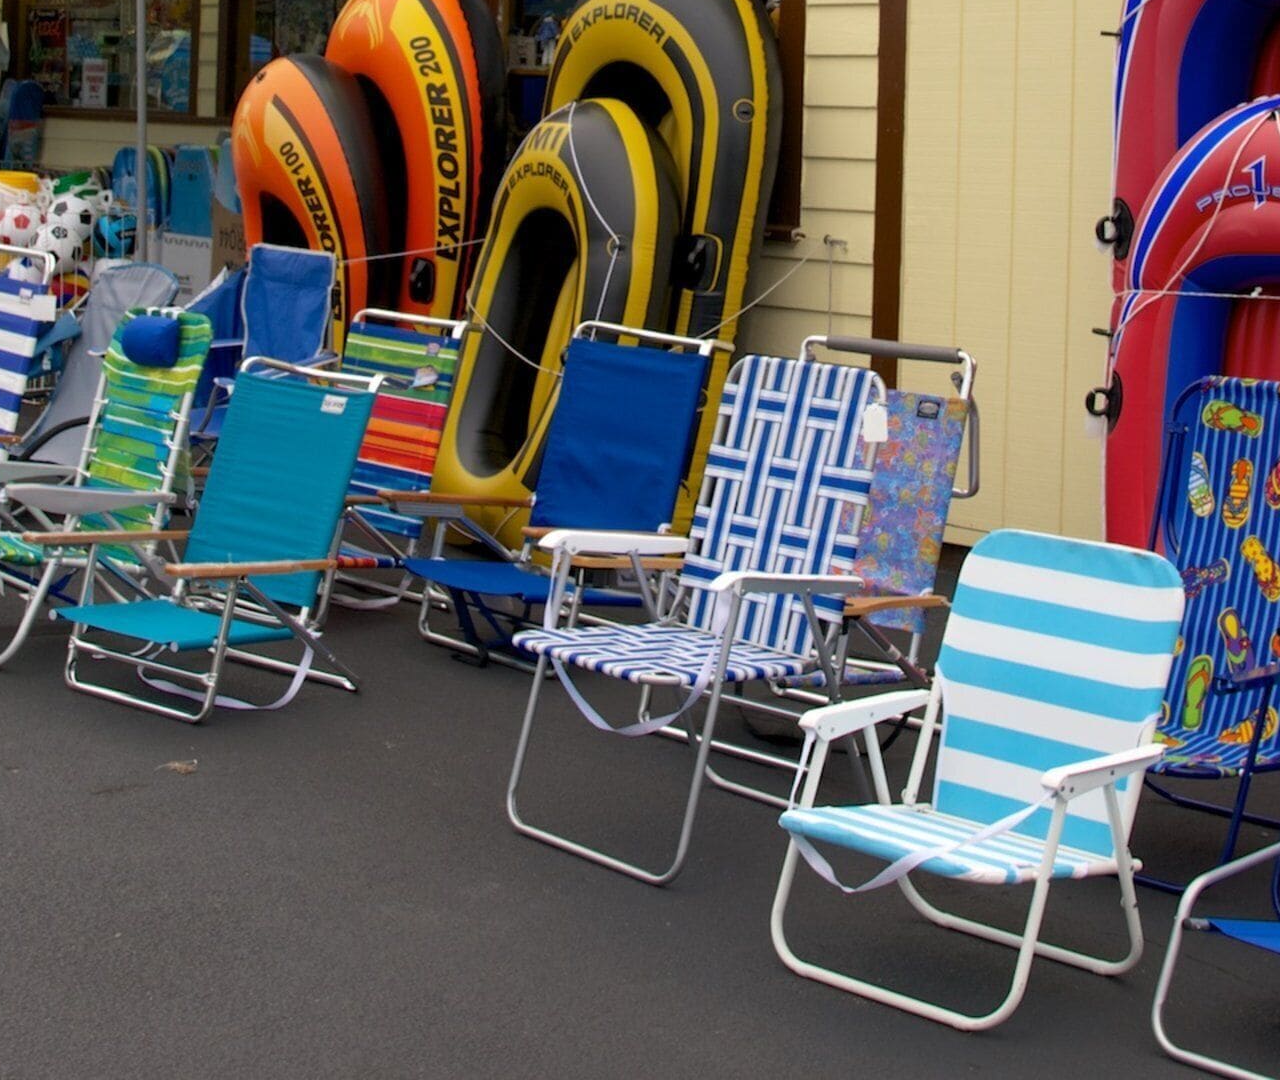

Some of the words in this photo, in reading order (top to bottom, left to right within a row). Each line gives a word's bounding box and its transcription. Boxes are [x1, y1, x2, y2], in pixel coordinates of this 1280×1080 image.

[570, 2, 666, 44] EXPLORER
[409, 35, 443, 78] 200
[527, 125, 563, 151] M1
[279, 141, 305, 176] 100
[426, 82, 460, 261] EXPLORER
[508, 161, 570, 197] EXPLORER
